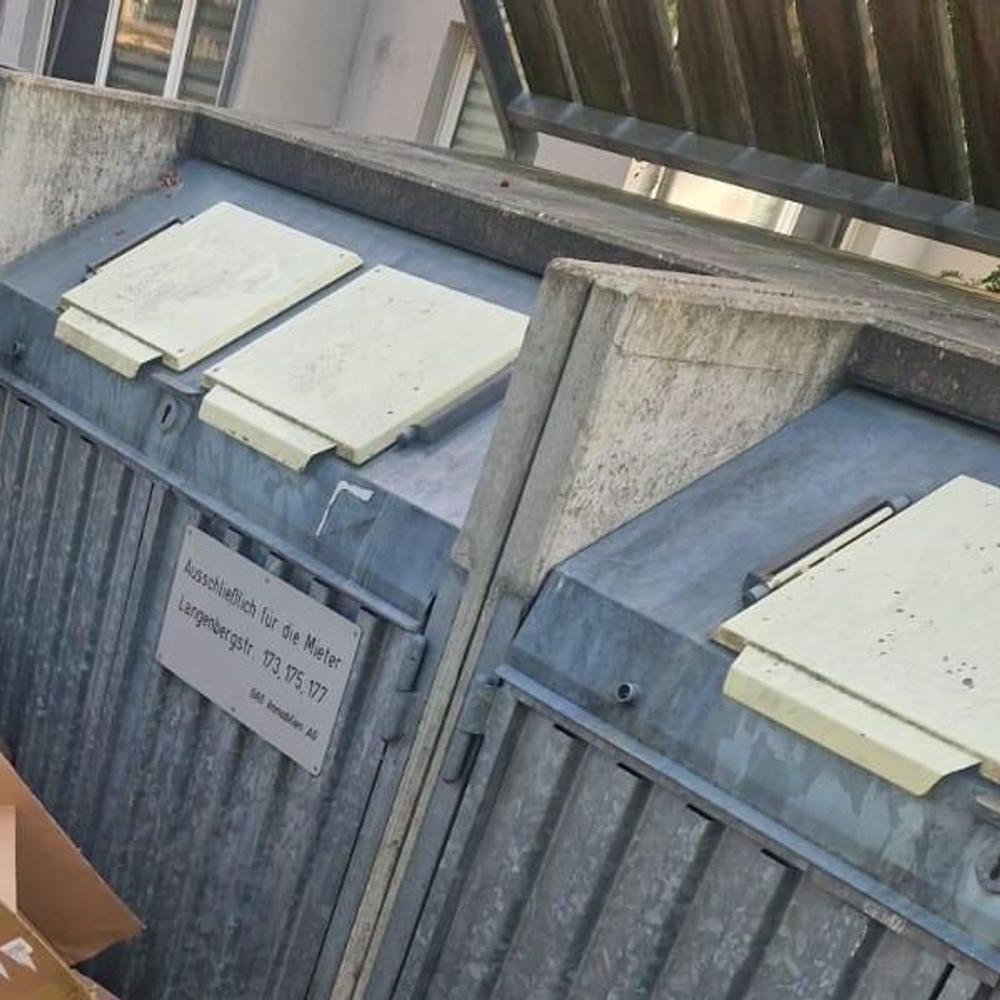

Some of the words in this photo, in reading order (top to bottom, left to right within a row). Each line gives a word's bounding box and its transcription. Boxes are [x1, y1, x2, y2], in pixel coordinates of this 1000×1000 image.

[183, 559, 257, 619] Ausschließlich
[259, 606, 279, 629] für
[281, 623, 300, 646] die
[303, 632, 342, 670] Mieter
